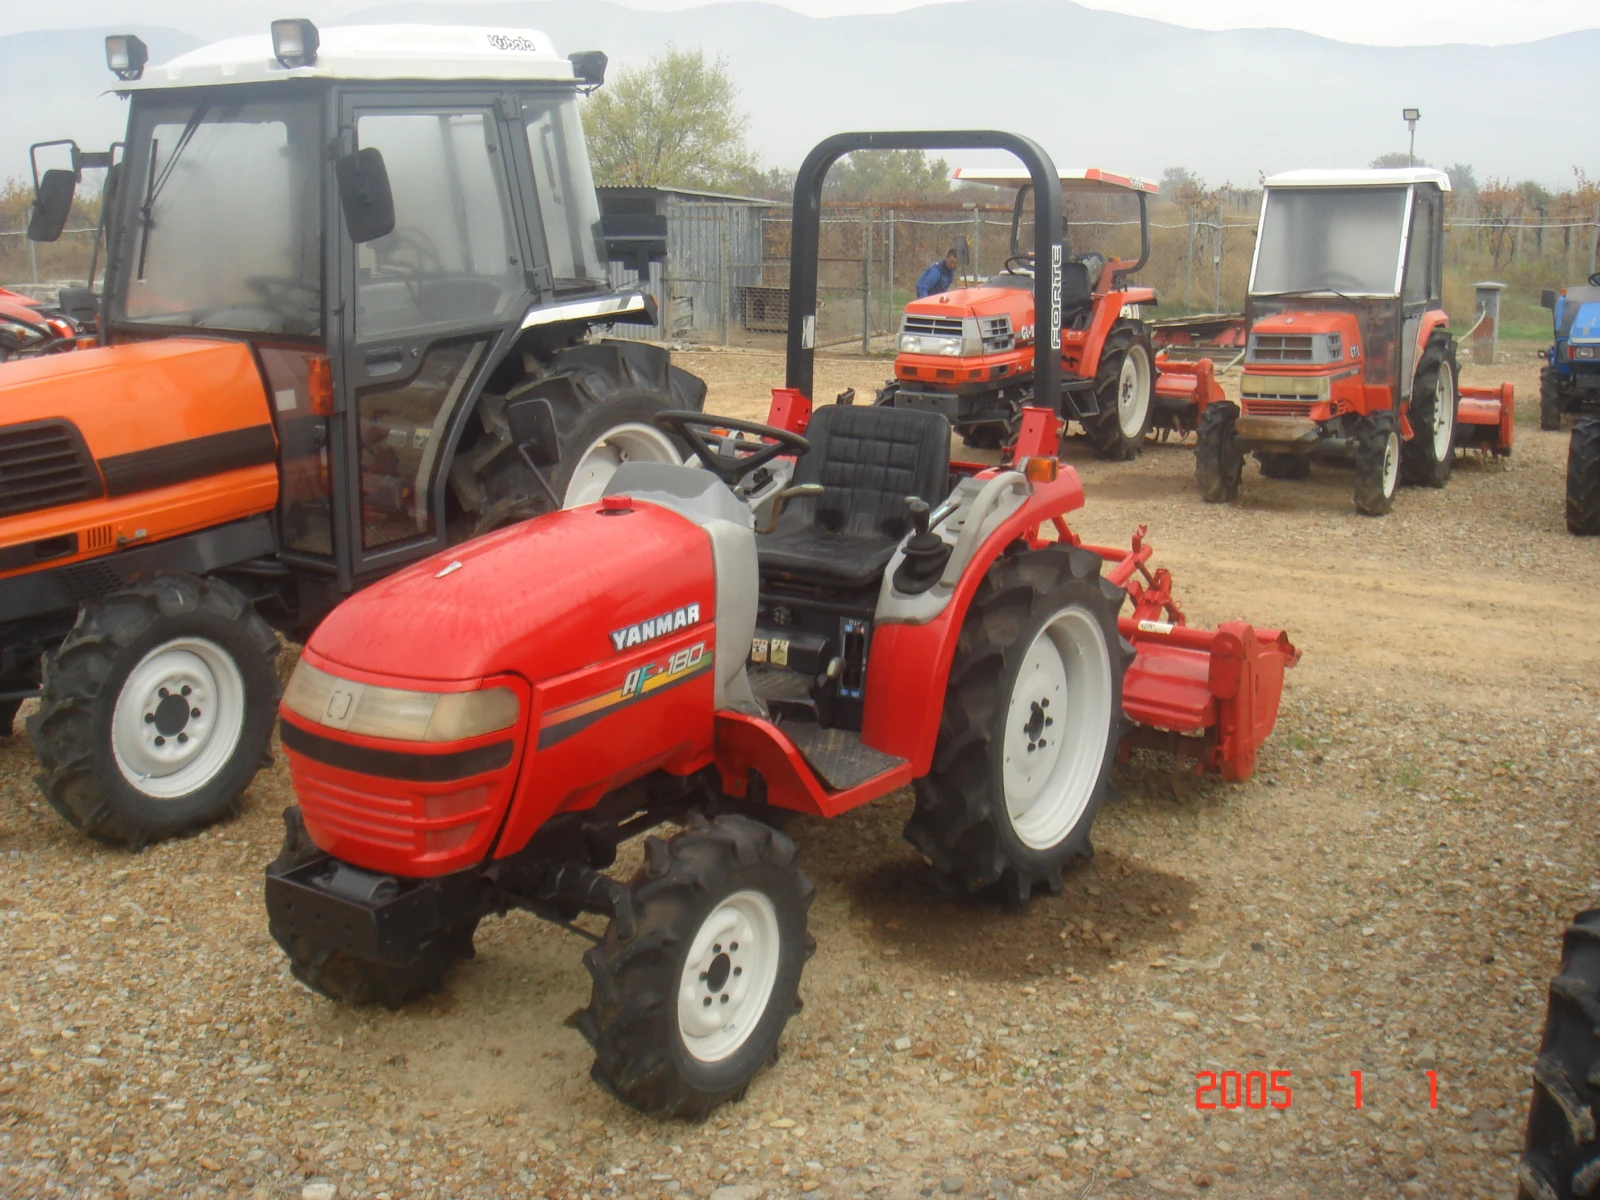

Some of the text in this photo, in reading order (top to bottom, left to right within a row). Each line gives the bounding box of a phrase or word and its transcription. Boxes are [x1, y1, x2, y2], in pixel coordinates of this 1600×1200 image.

[487, 34, 536, 51] Kubota
[1051, 245, 1062, 349] FORTE
[609, 602, 700, 651] YANMAR
